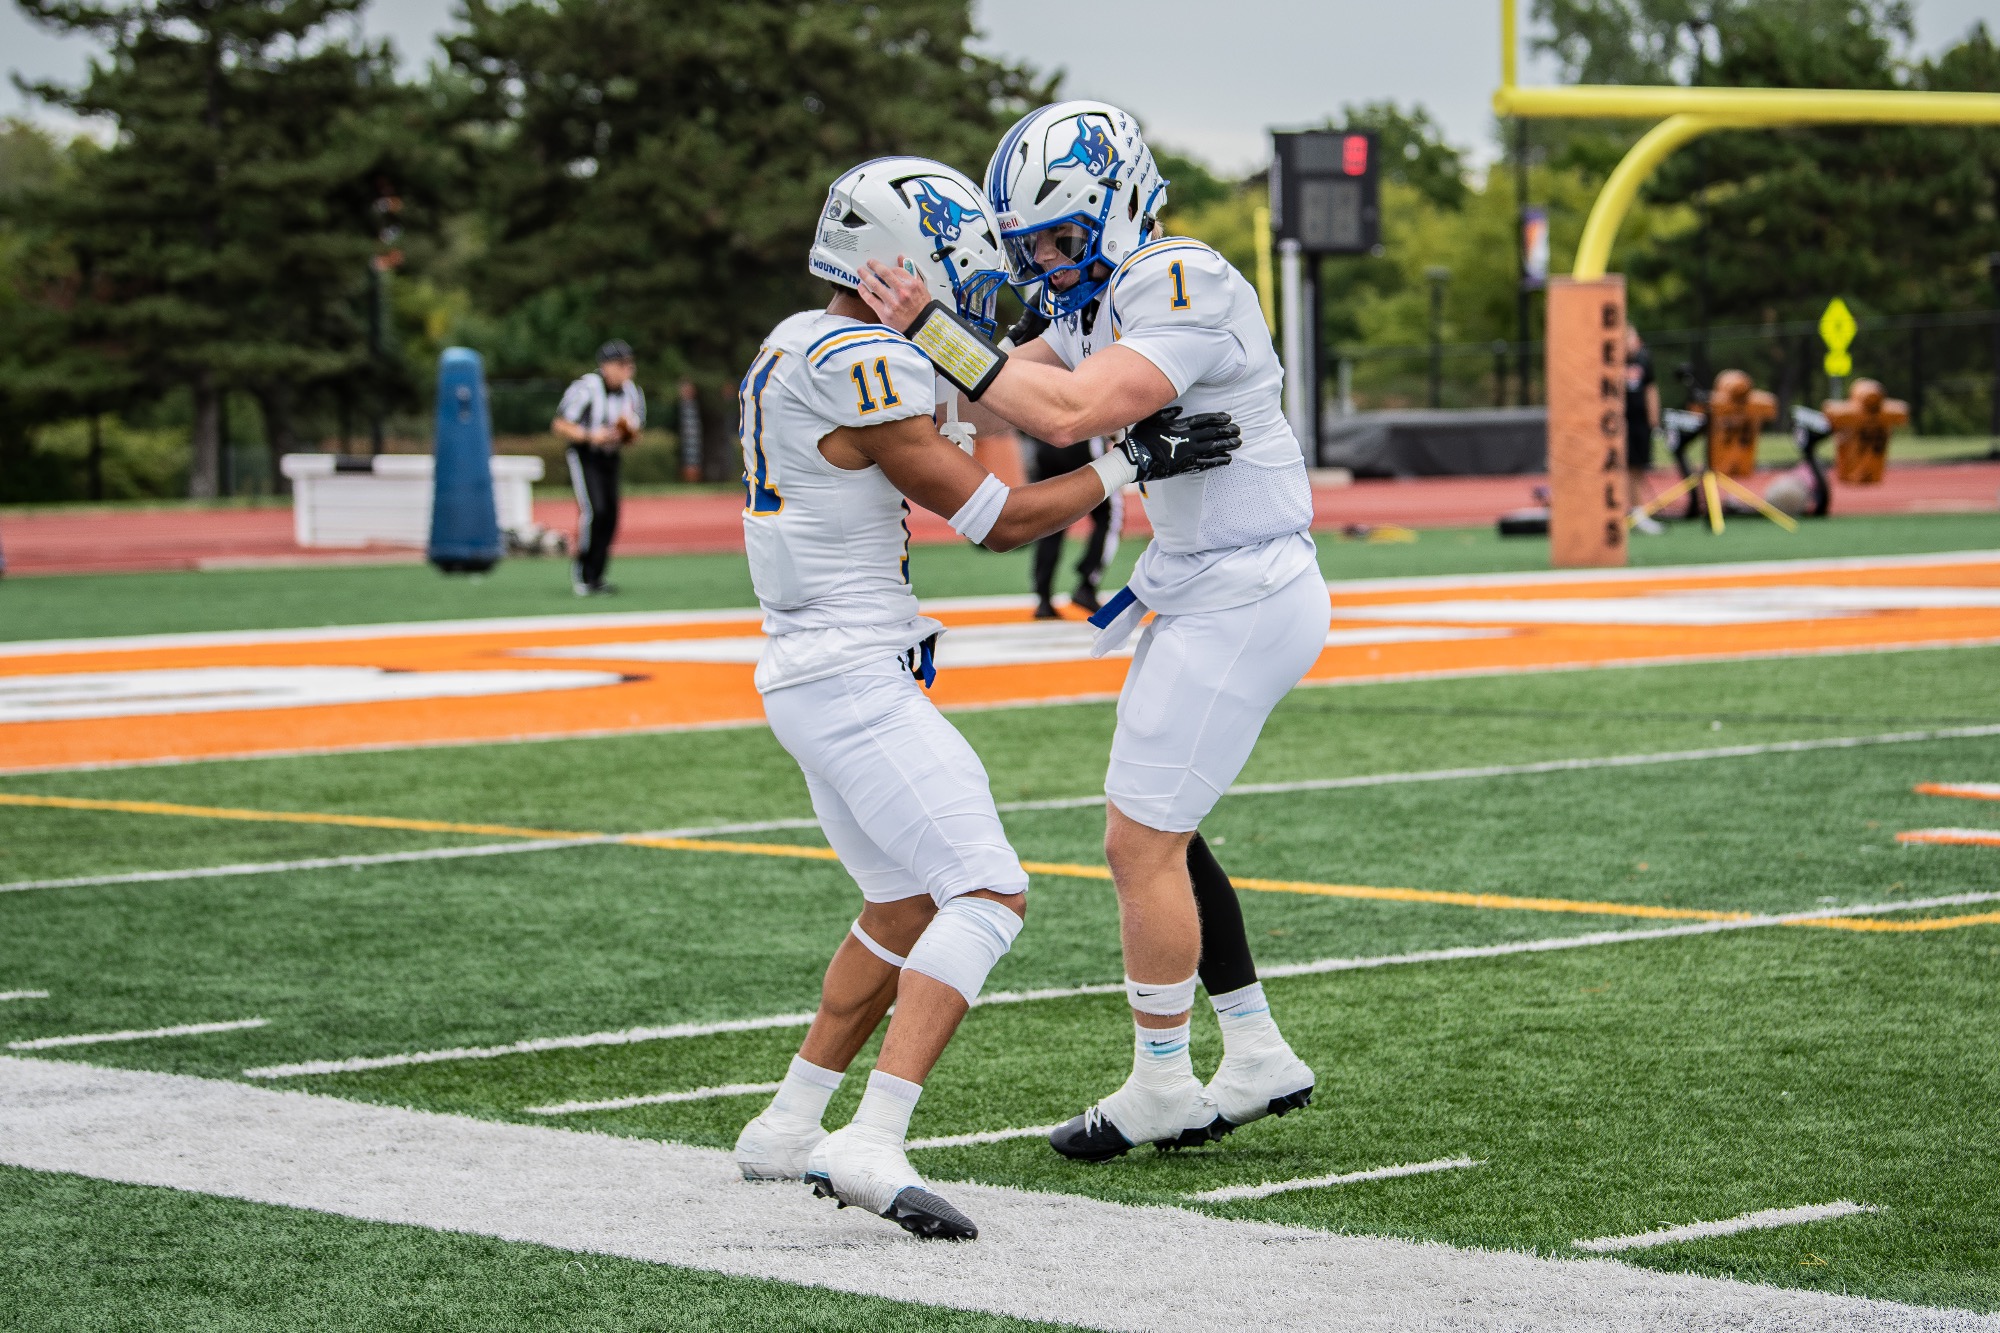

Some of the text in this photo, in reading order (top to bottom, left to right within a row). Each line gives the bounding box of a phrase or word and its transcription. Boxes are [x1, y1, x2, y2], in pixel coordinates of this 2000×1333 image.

[1168, 259, 1191, 311] 1
[850, 356, 902, 416] 11
[1601, 303, 1623, 548] BENGALS
